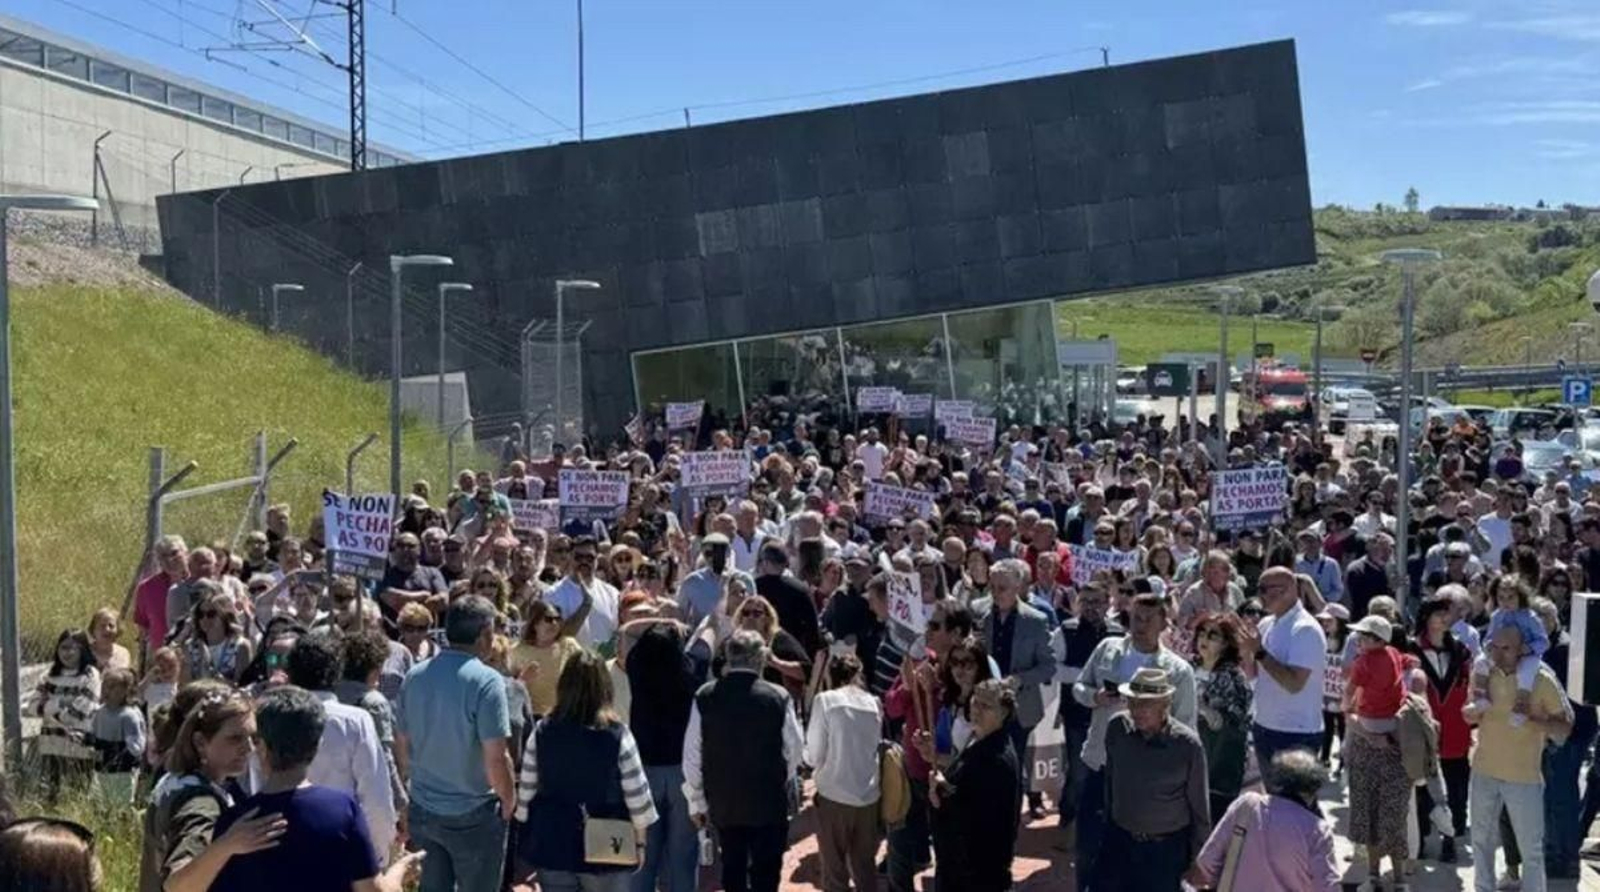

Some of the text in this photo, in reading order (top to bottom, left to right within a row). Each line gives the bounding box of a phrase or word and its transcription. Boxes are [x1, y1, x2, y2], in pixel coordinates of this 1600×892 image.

[1570, 380, 1587, 402] P
[697, 453, 718, 461] NON
[575, 472, 598, 481] NON
[602, 472, 626, 482] PARA
[1224, 471, 1251, 485] NON
[1255, 468, 1287, 482] PARA
[568, 493, 619, 502] AS PORTA
[1216, 482, 1284, 498] PECHAMOS
[323, 491, 391, 515] SE NON
[1217, 500, 1233, 512] AS
[338, 530, 359, 548] AS
[1086, 550, 1109, 562] NON
[1035, 758, 1059, 780] DE
